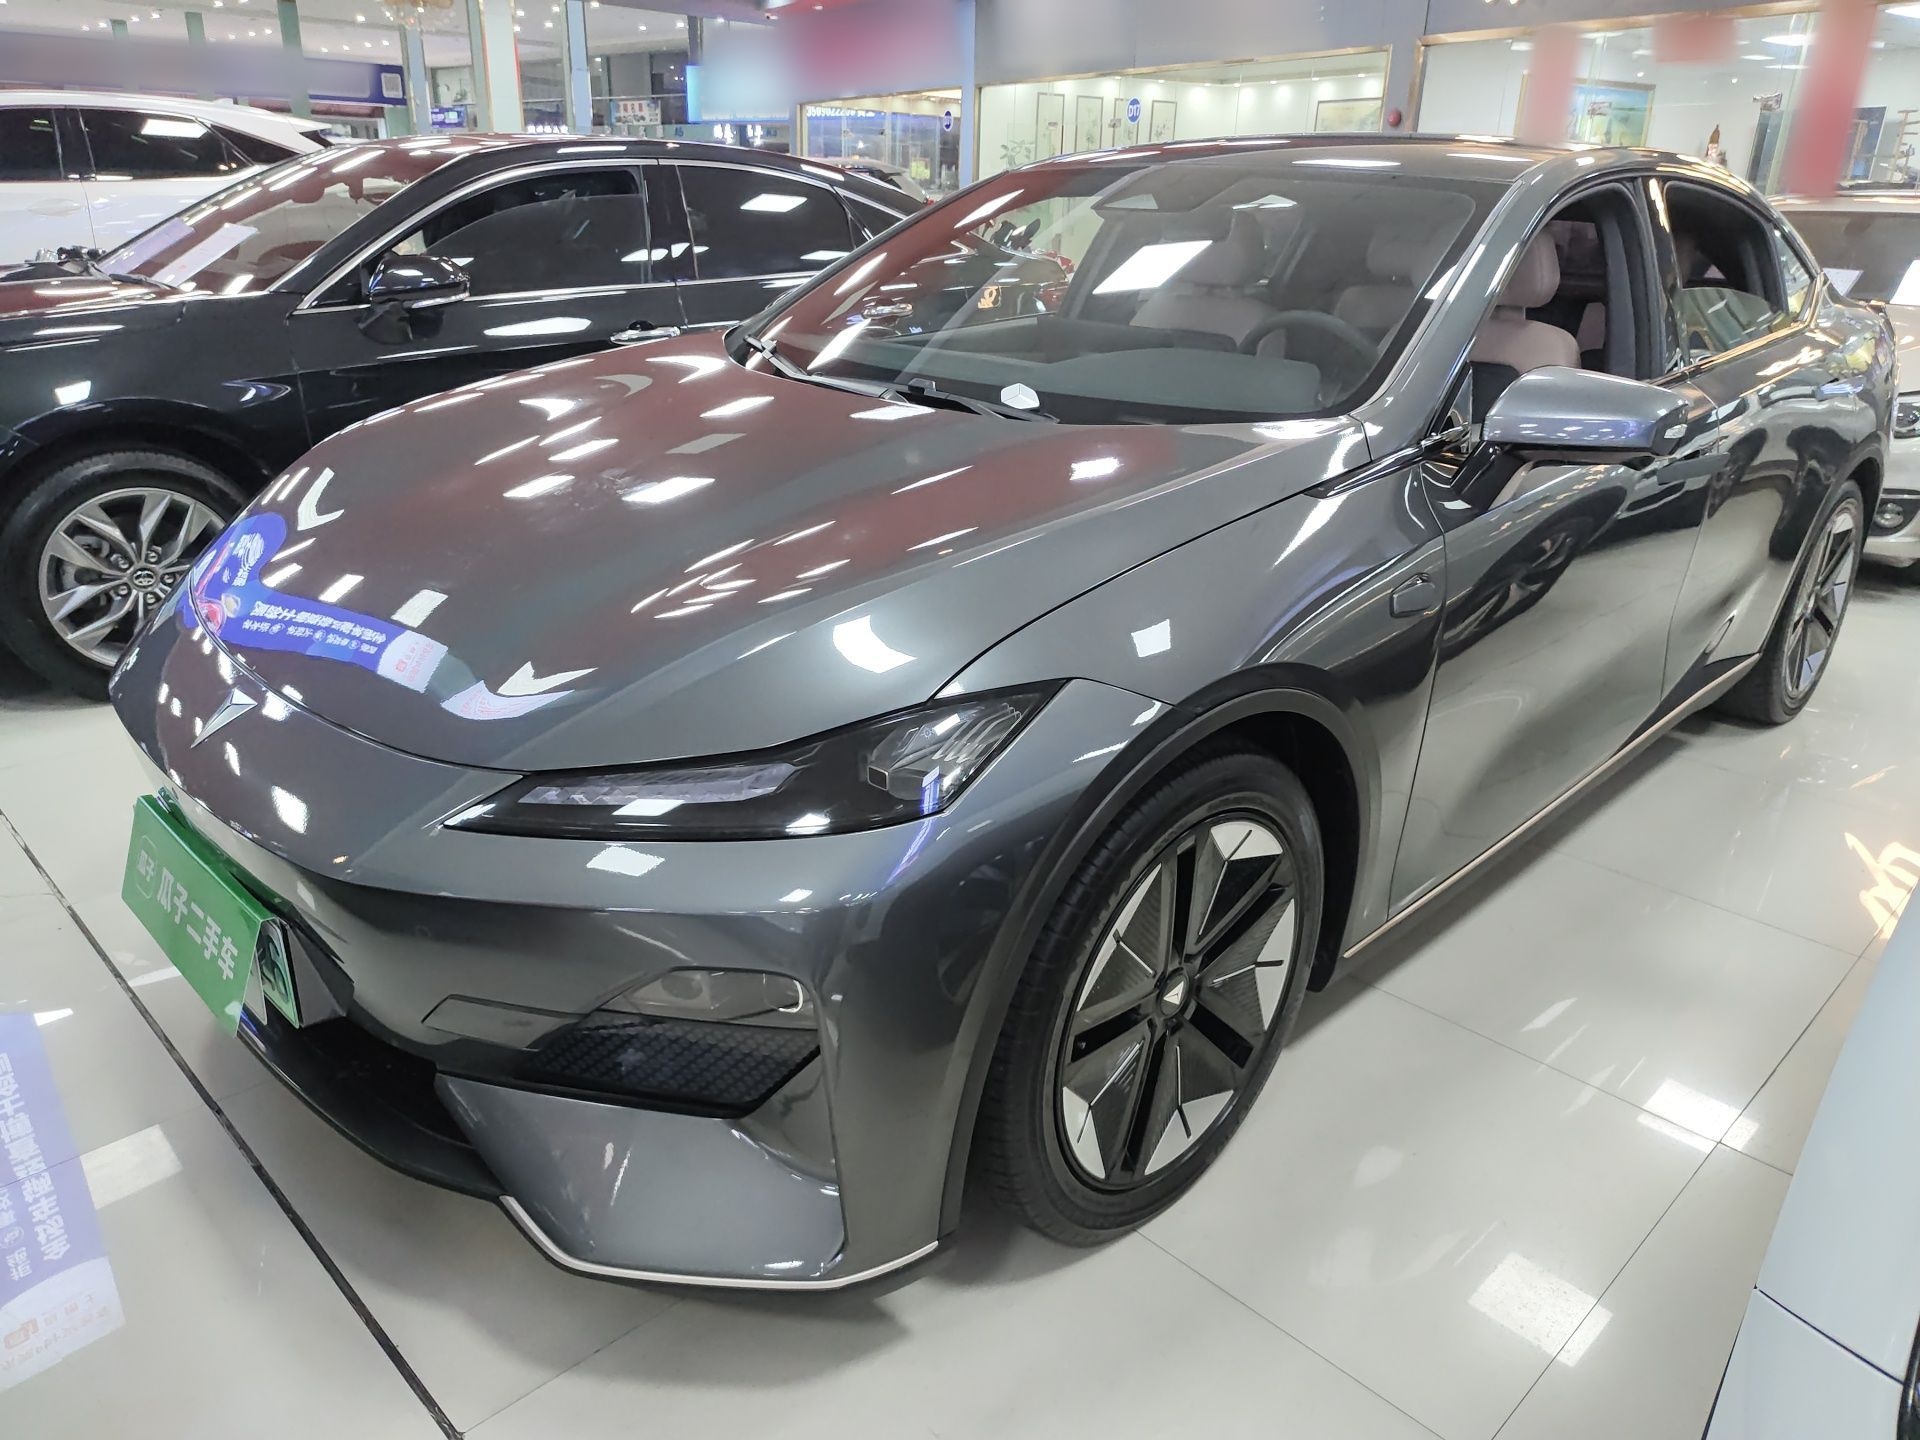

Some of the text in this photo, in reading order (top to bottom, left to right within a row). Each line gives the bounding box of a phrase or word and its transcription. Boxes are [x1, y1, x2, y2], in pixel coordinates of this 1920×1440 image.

[1128, 104, 1140, 117] D17
[157, 867, 239, 981] 瓜子二手车
